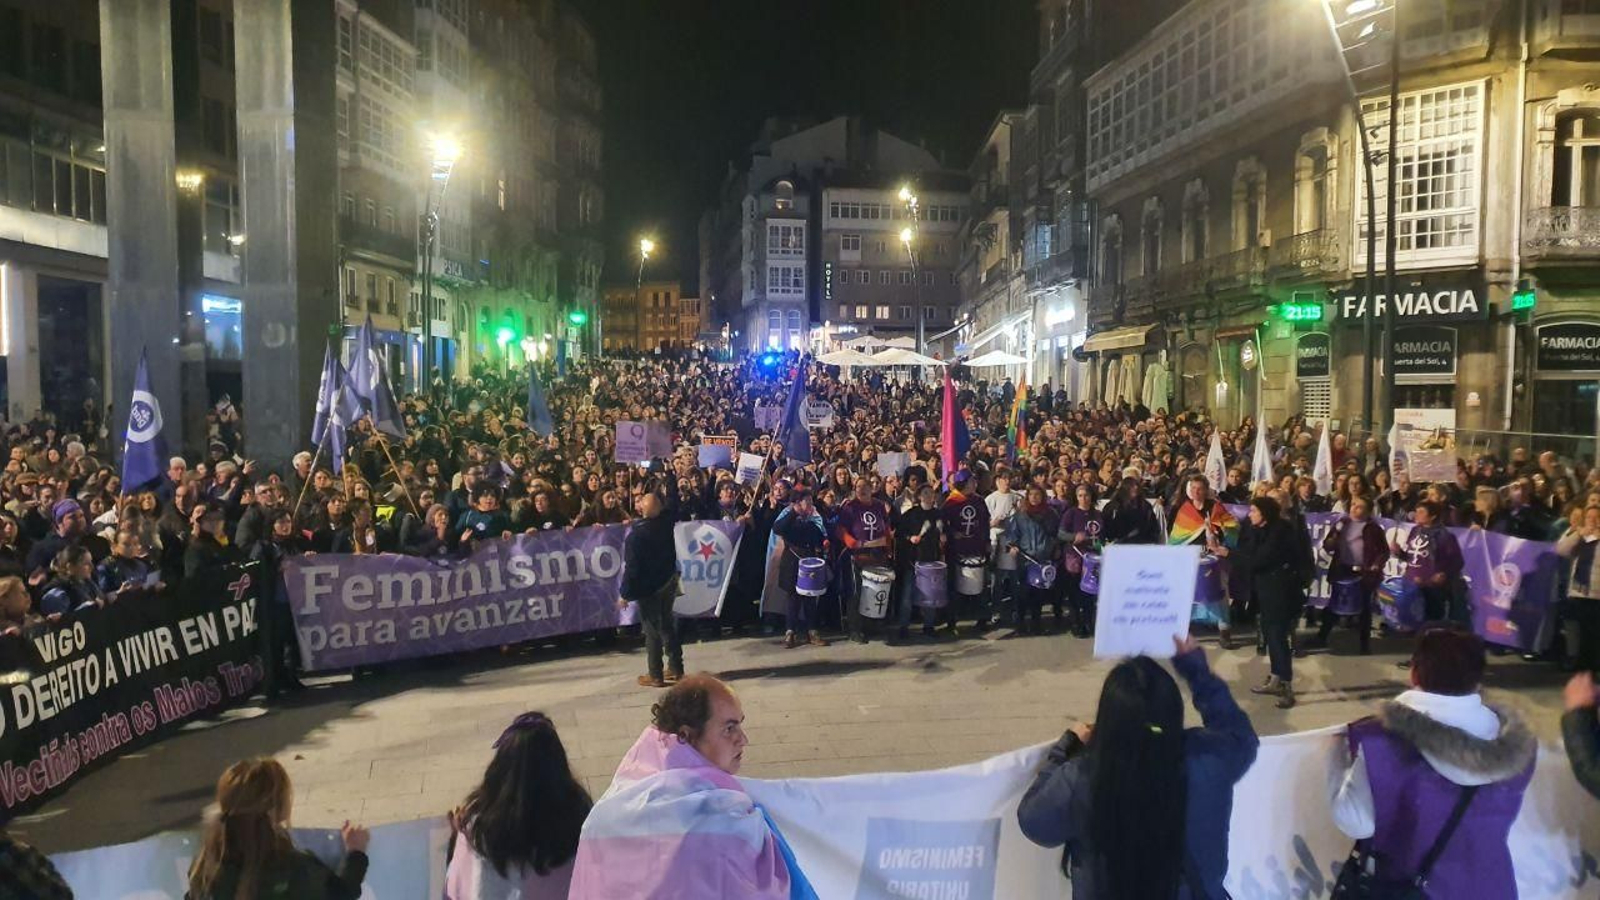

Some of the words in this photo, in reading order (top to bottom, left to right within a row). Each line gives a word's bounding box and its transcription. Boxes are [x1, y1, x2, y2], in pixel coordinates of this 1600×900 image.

[1288, 305, 1322, 319] 21:15
[1394, 341, 1451, 354] ARMACIA
[1394, 358, 1414, 366] uerta
[300, 545, 621, 615] Feminismo
[675, 558, 724, 588] ng
[34, 620, 86, 663] VIGO
[301, 617, 397, 661] para
[410, 592, 564, 640] avanzar
[11, 653, 100, 730] DEREITO
[105, 647, 119, 688] A
[117, 626, 180, 677] VIVIR
[178, 612, 220, 656] EN
[222, 598, 258, 642] PAZ
[79, 712, 133, 765] contra
[130, 701, 157, 736] os
[153, 676, 221, 725] Malos
